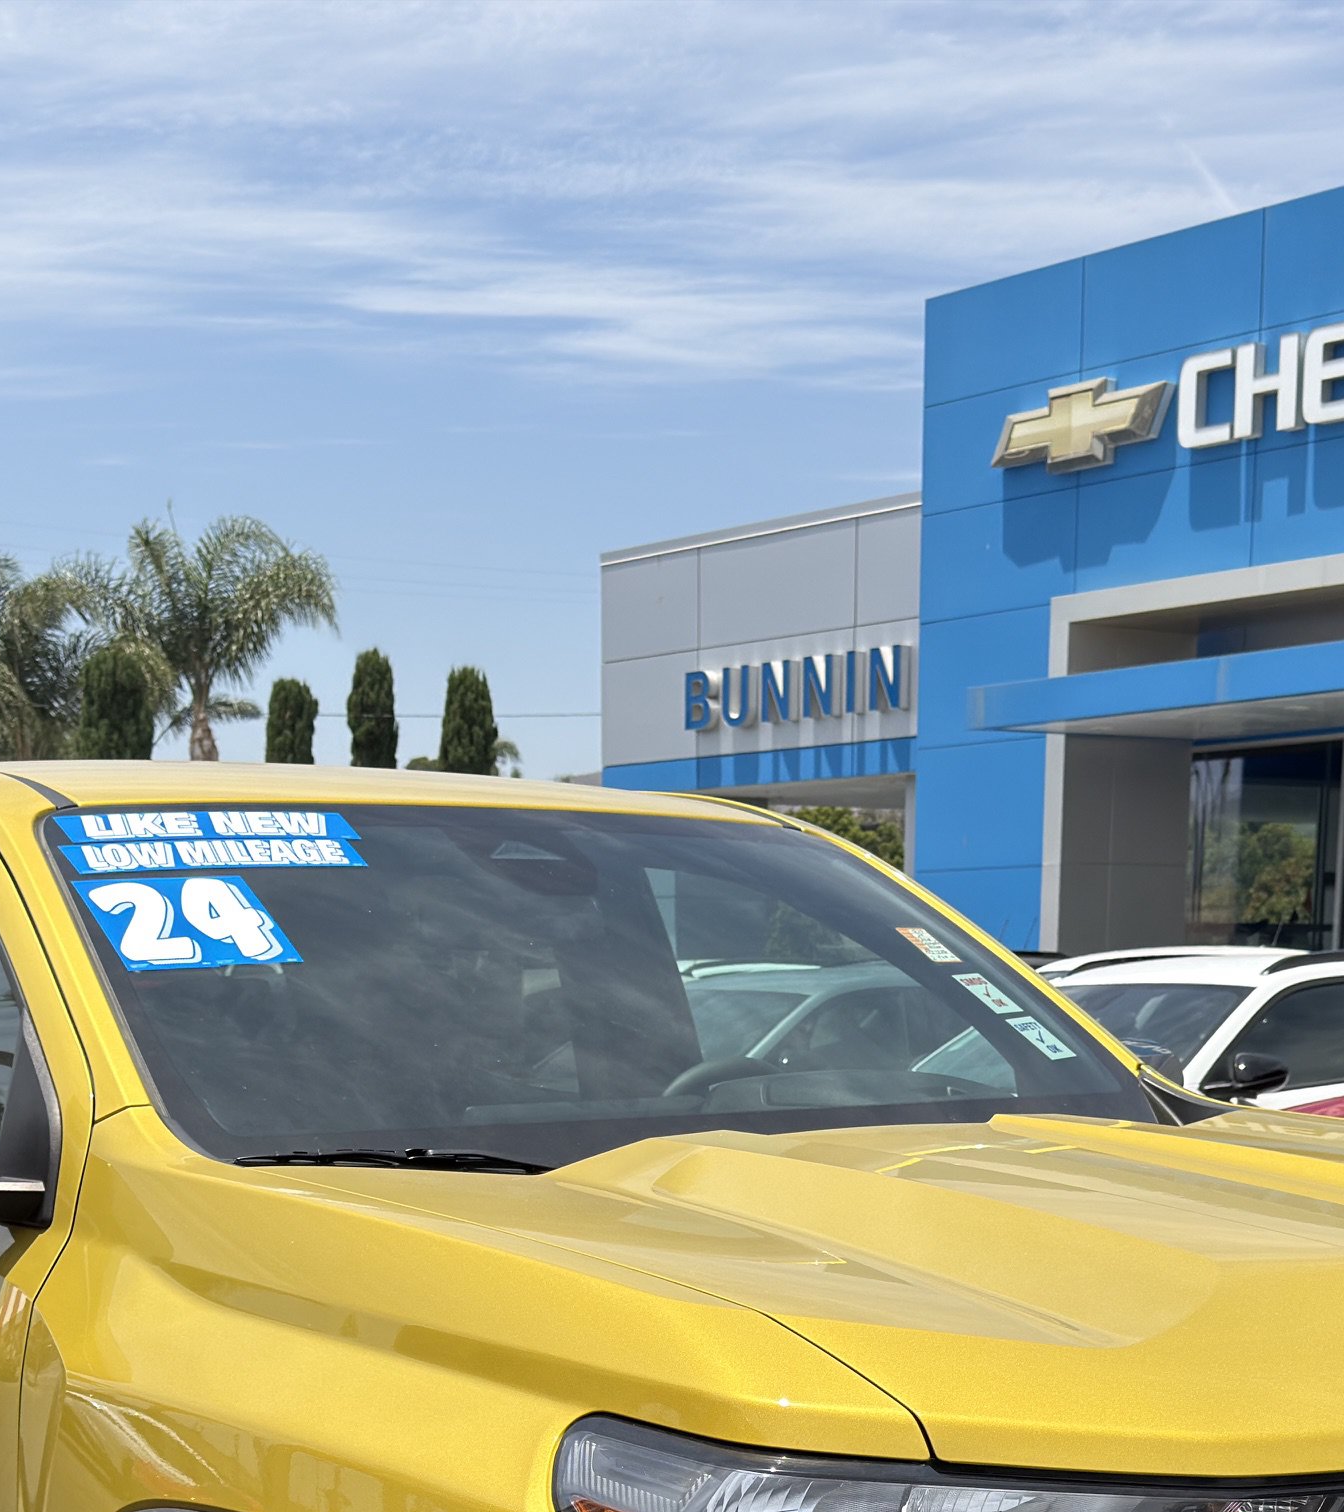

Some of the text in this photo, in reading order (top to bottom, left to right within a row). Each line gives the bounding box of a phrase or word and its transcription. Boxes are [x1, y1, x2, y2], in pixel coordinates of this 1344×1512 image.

[685, 644, 913, 731] BUNNIN
[80, 812, 327, 838] LIKE NEW
[81, 840, 350, 870] LOW MILEAGE
[88, 878, 284, 965] 24
[1014, 1022, 1041, 1032] SAFETY
